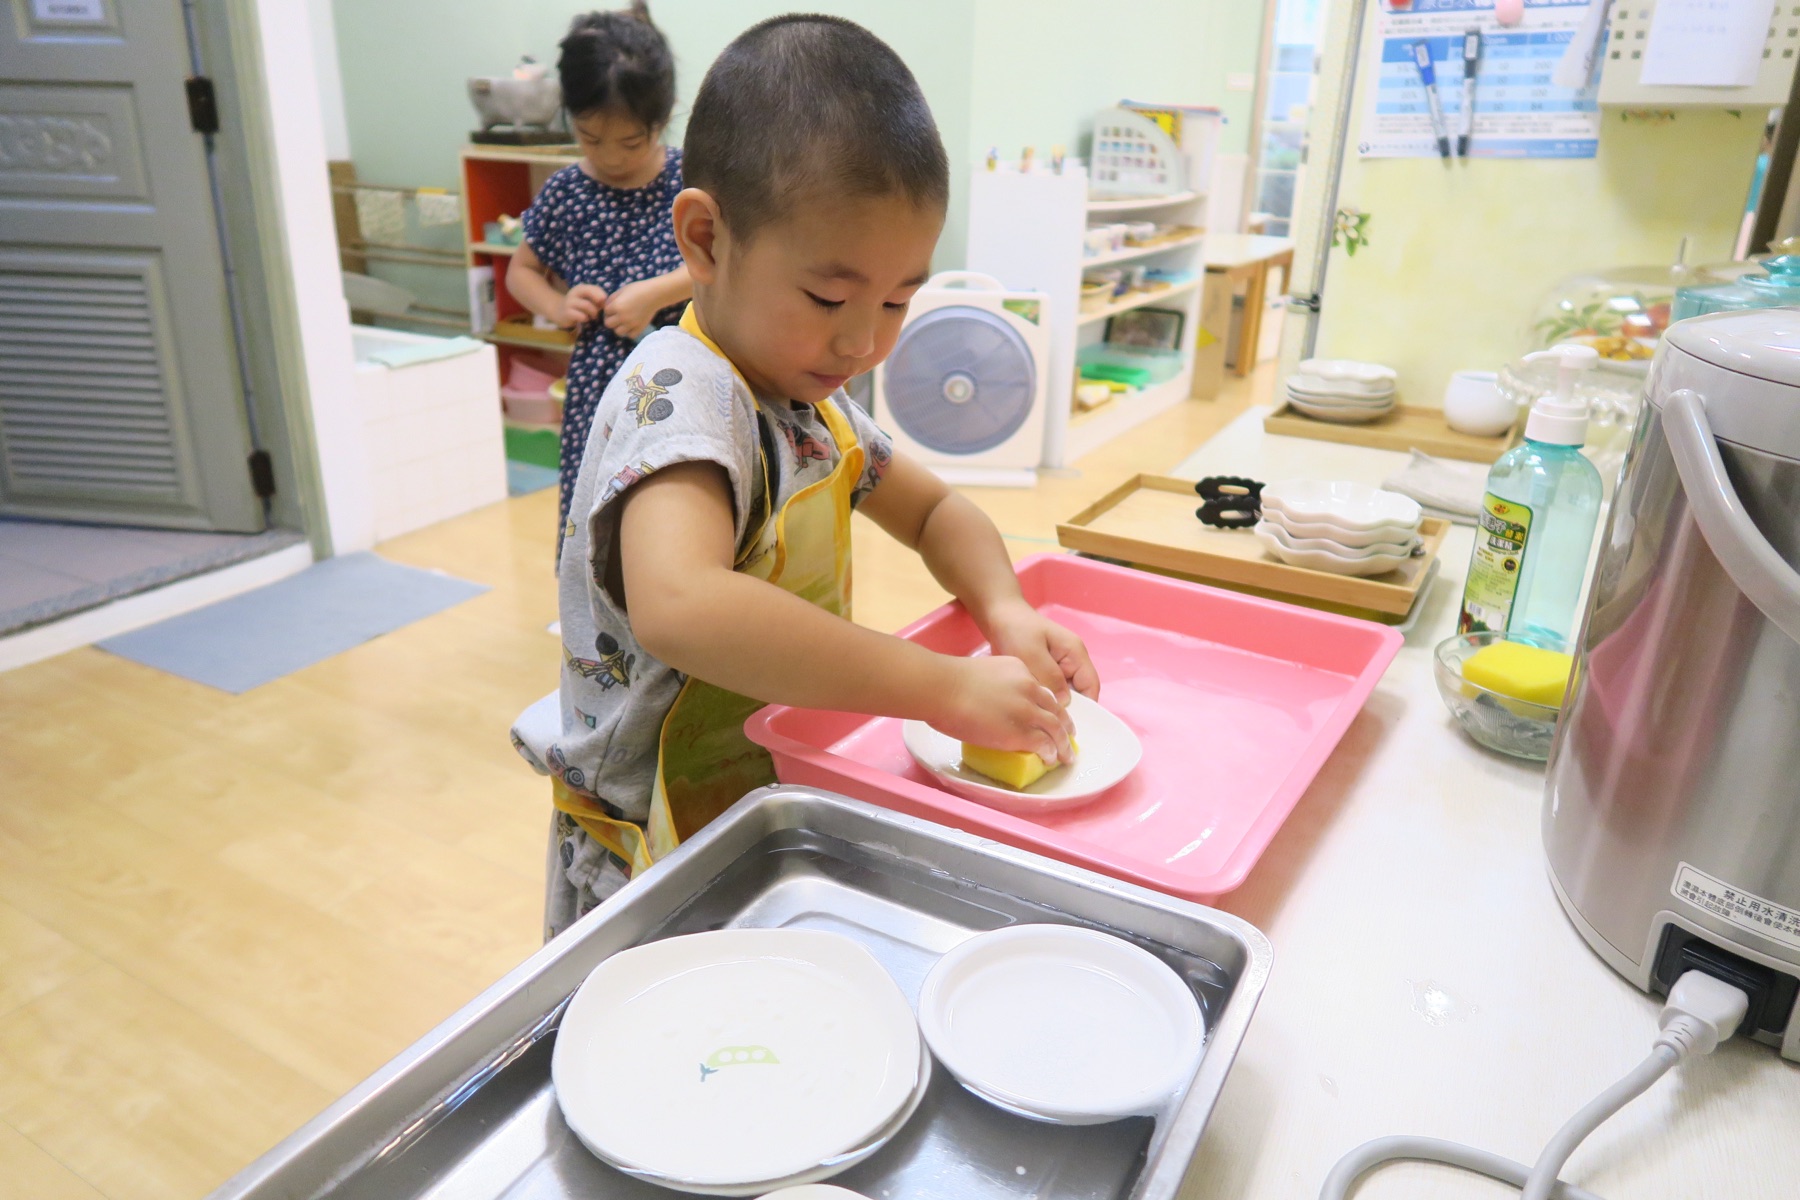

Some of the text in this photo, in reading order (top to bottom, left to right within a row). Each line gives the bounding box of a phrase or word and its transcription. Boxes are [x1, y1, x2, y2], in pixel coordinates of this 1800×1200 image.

[1723, 889, 1800, 928] 禁止用水清洗
